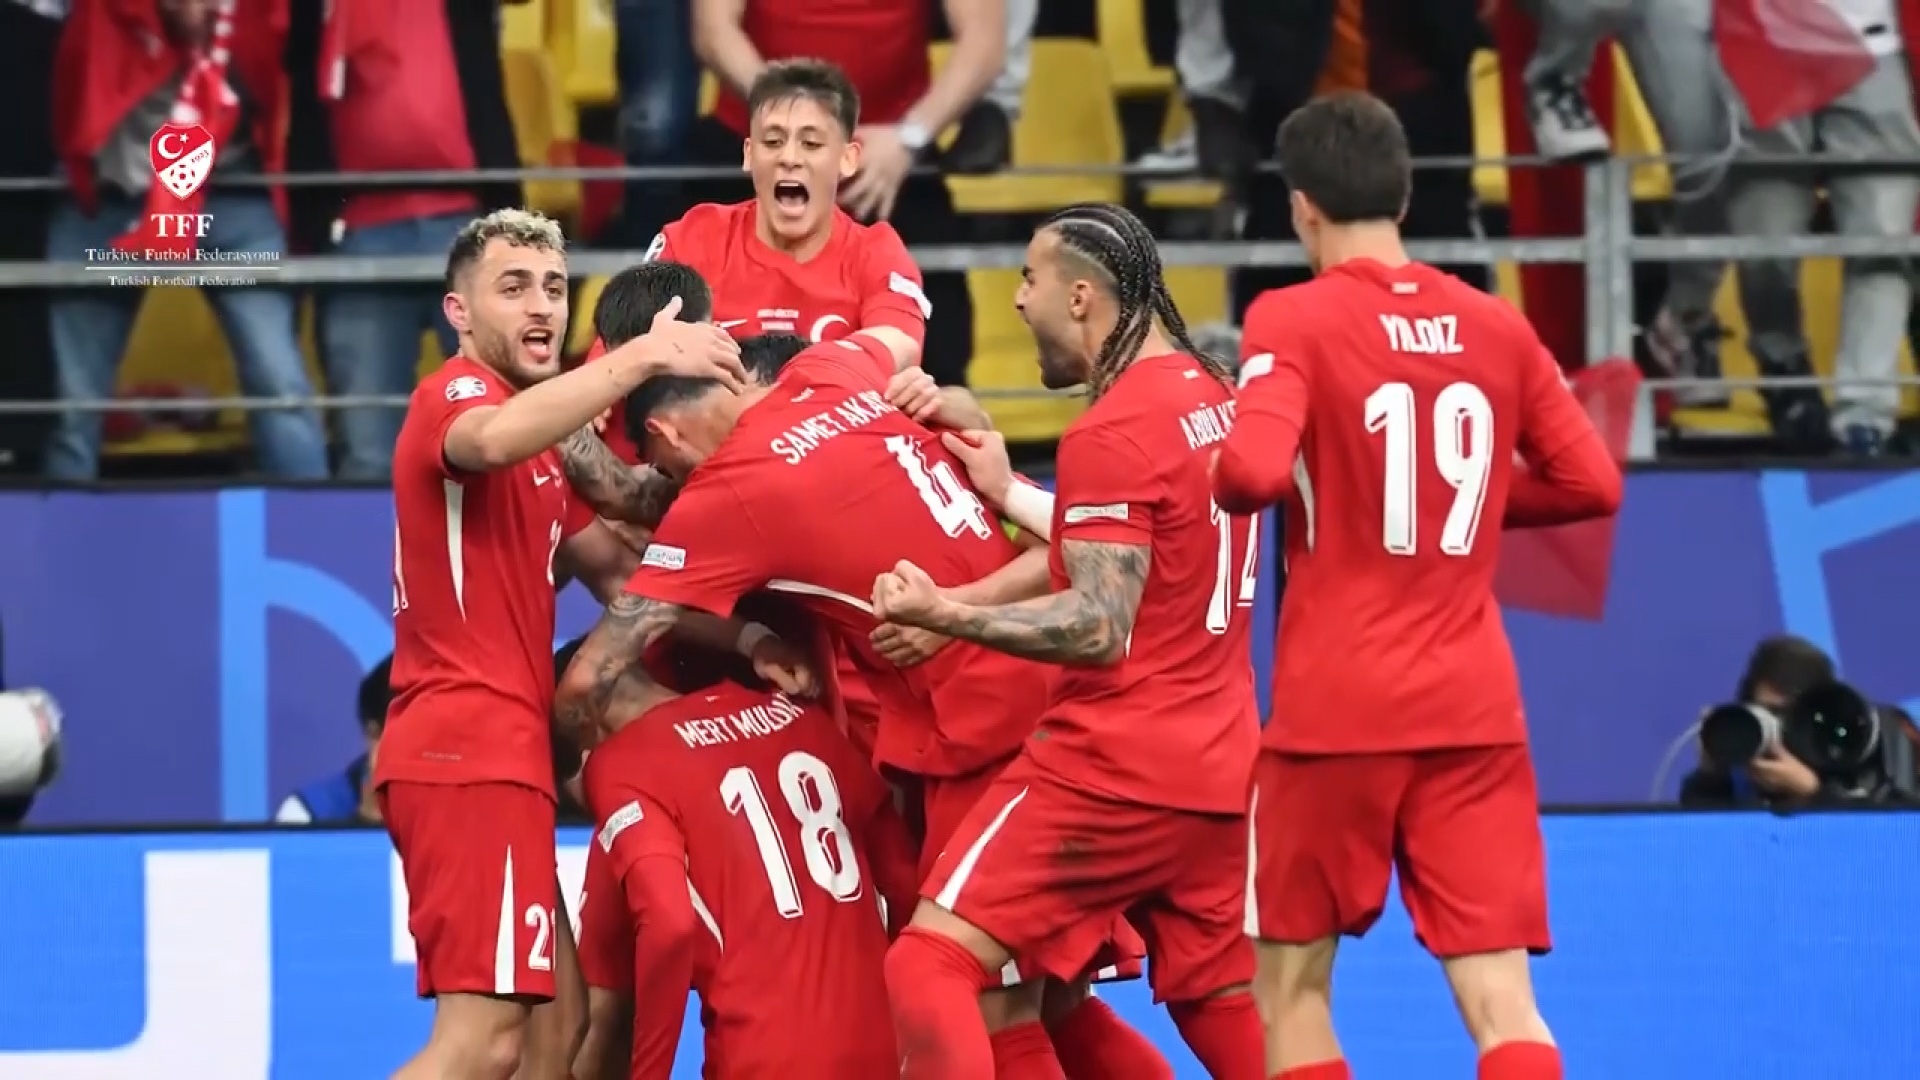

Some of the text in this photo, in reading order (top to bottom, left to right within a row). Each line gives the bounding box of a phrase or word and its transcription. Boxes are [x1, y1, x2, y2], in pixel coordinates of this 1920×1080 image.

[1378, 314, 1464, 355] YILDIZ
[771, 412, 849, 466] SAMET
[1364, 381, 1494, 556] 19
[884, 434, 993, 540] 4
[673, 715, 739, 748] MERT
[719, 750, 863, 919] 18
[524, 902, 556, 973] 2
